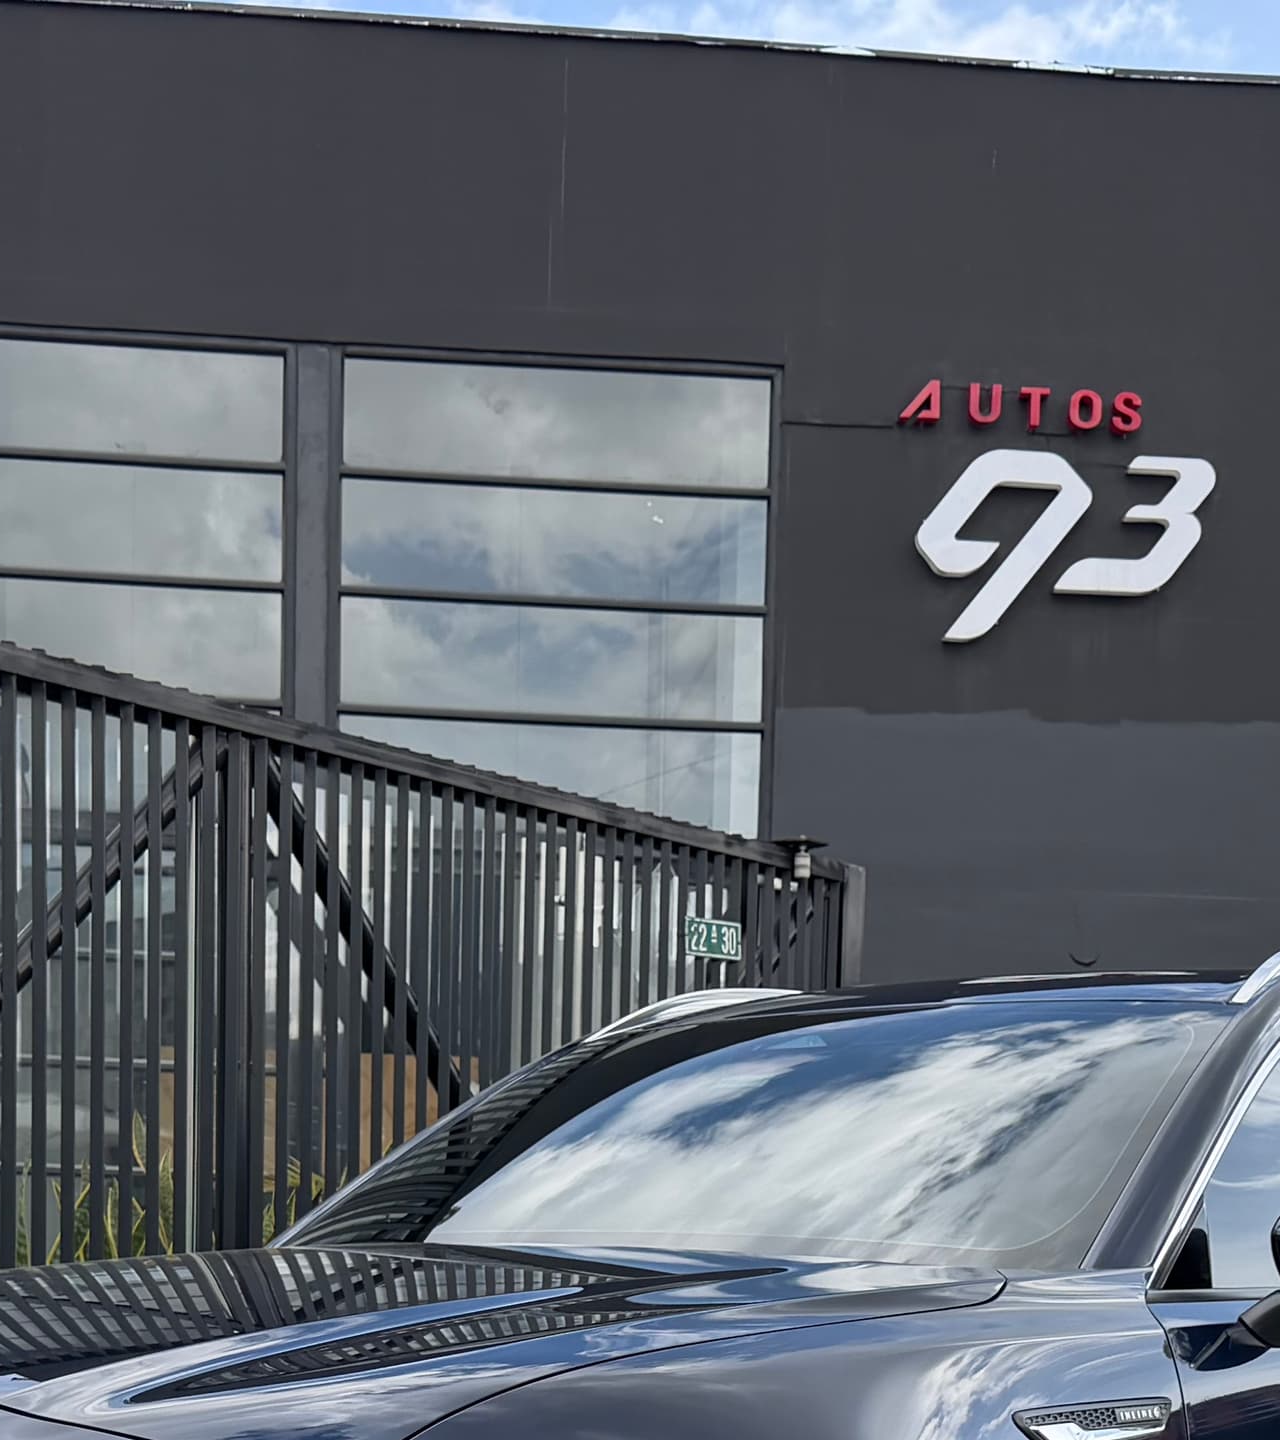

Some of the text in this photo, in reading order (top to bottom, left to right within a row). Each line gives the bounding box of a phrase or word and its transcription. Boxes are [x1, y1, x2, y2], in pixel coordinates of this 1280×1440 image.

[897, 379, 1144, 436] AUTOS
[914, 448, 1217, 643] 93
[690, 924, 708, 951] 22
[721, 926, 737, 955] 30
